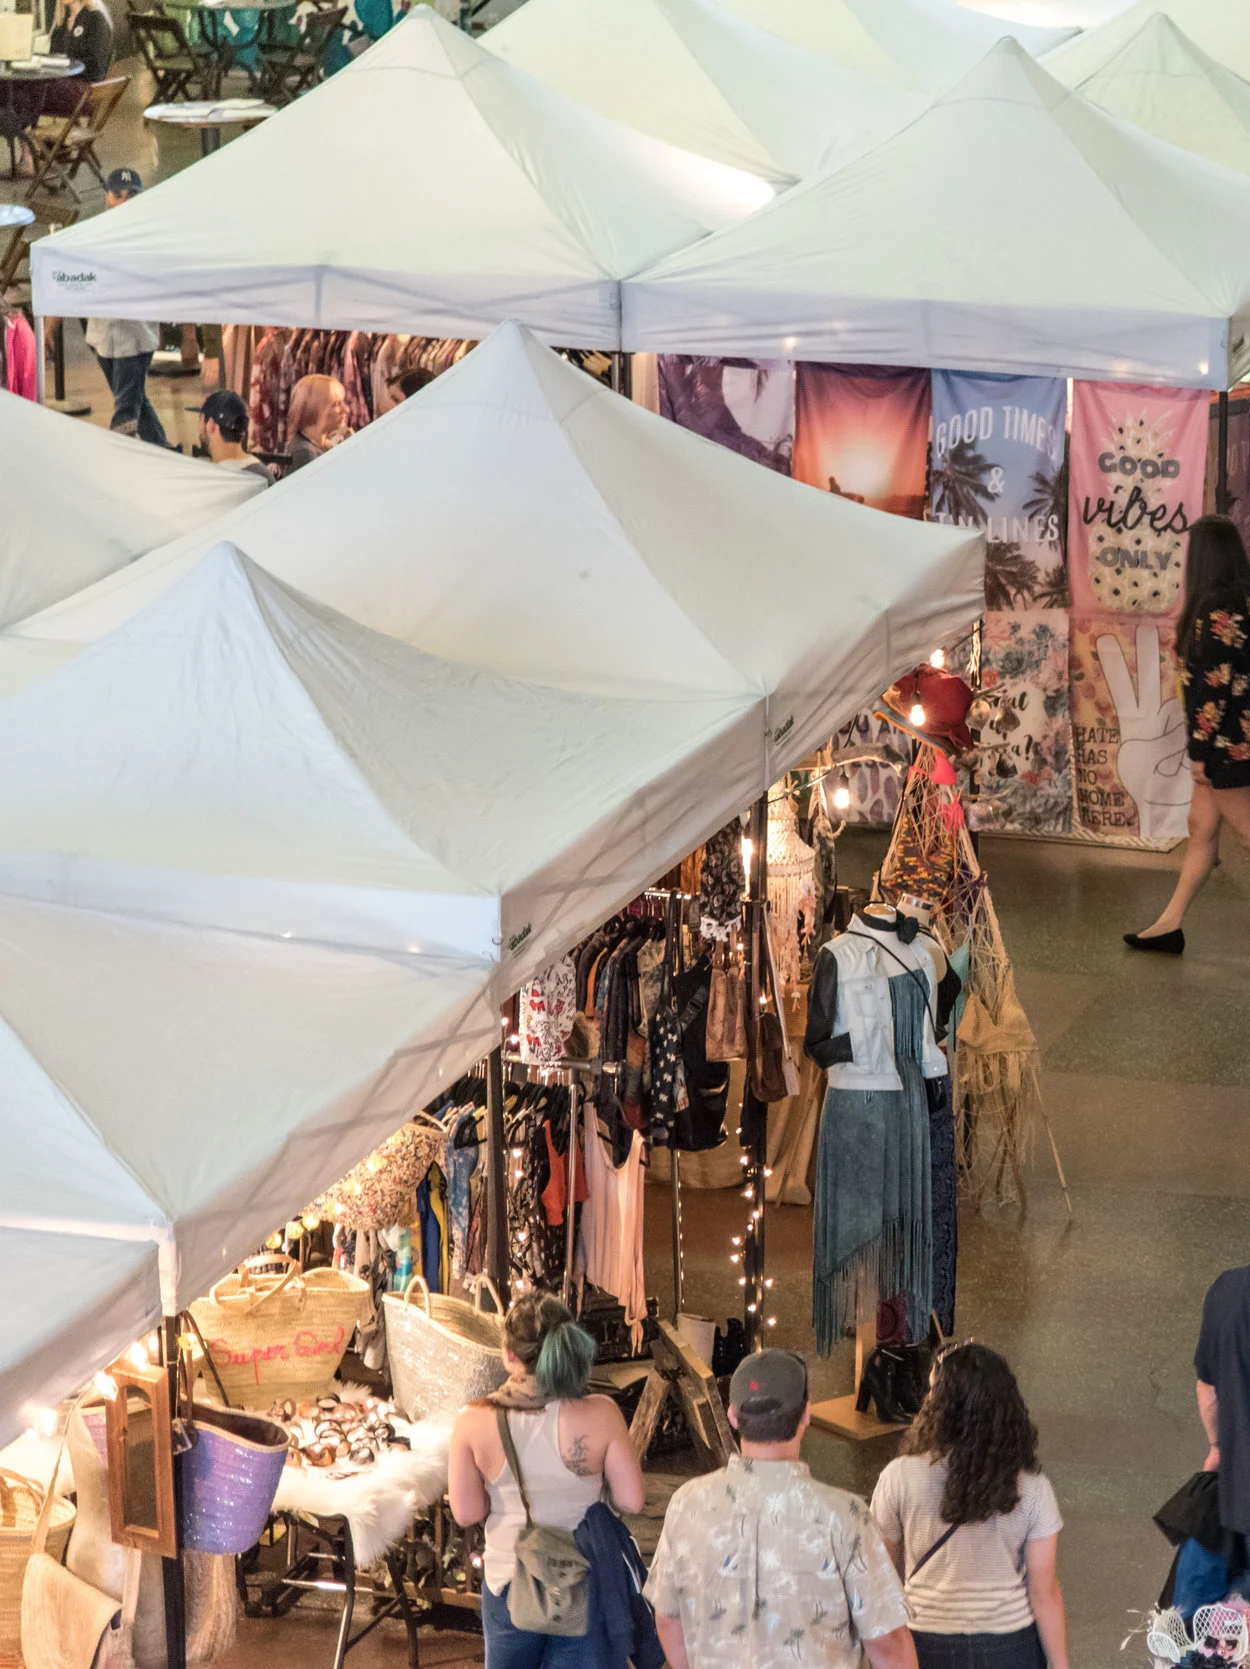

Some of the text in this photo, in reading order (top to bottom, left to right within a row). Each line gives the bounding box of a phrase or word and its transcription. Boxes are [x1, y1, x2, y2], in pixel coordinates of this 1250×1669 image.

[936, 406, 993, 458] GOOD
[1098, 452, 1180, 479] GOOD
[1083, 486, 1193, 534] vibes
[985, 514, 1060, 544] LINES
[1098, 546, 1172, 570] ONLY
[1075, 727, 1119, 745] HATE
[1076, 747, 1108, 765] HAS
[1076, 767, 1098, 785] NO
[1078, 787, 1125, 807] HOME
[211, 1338, 289, 1385] Super
